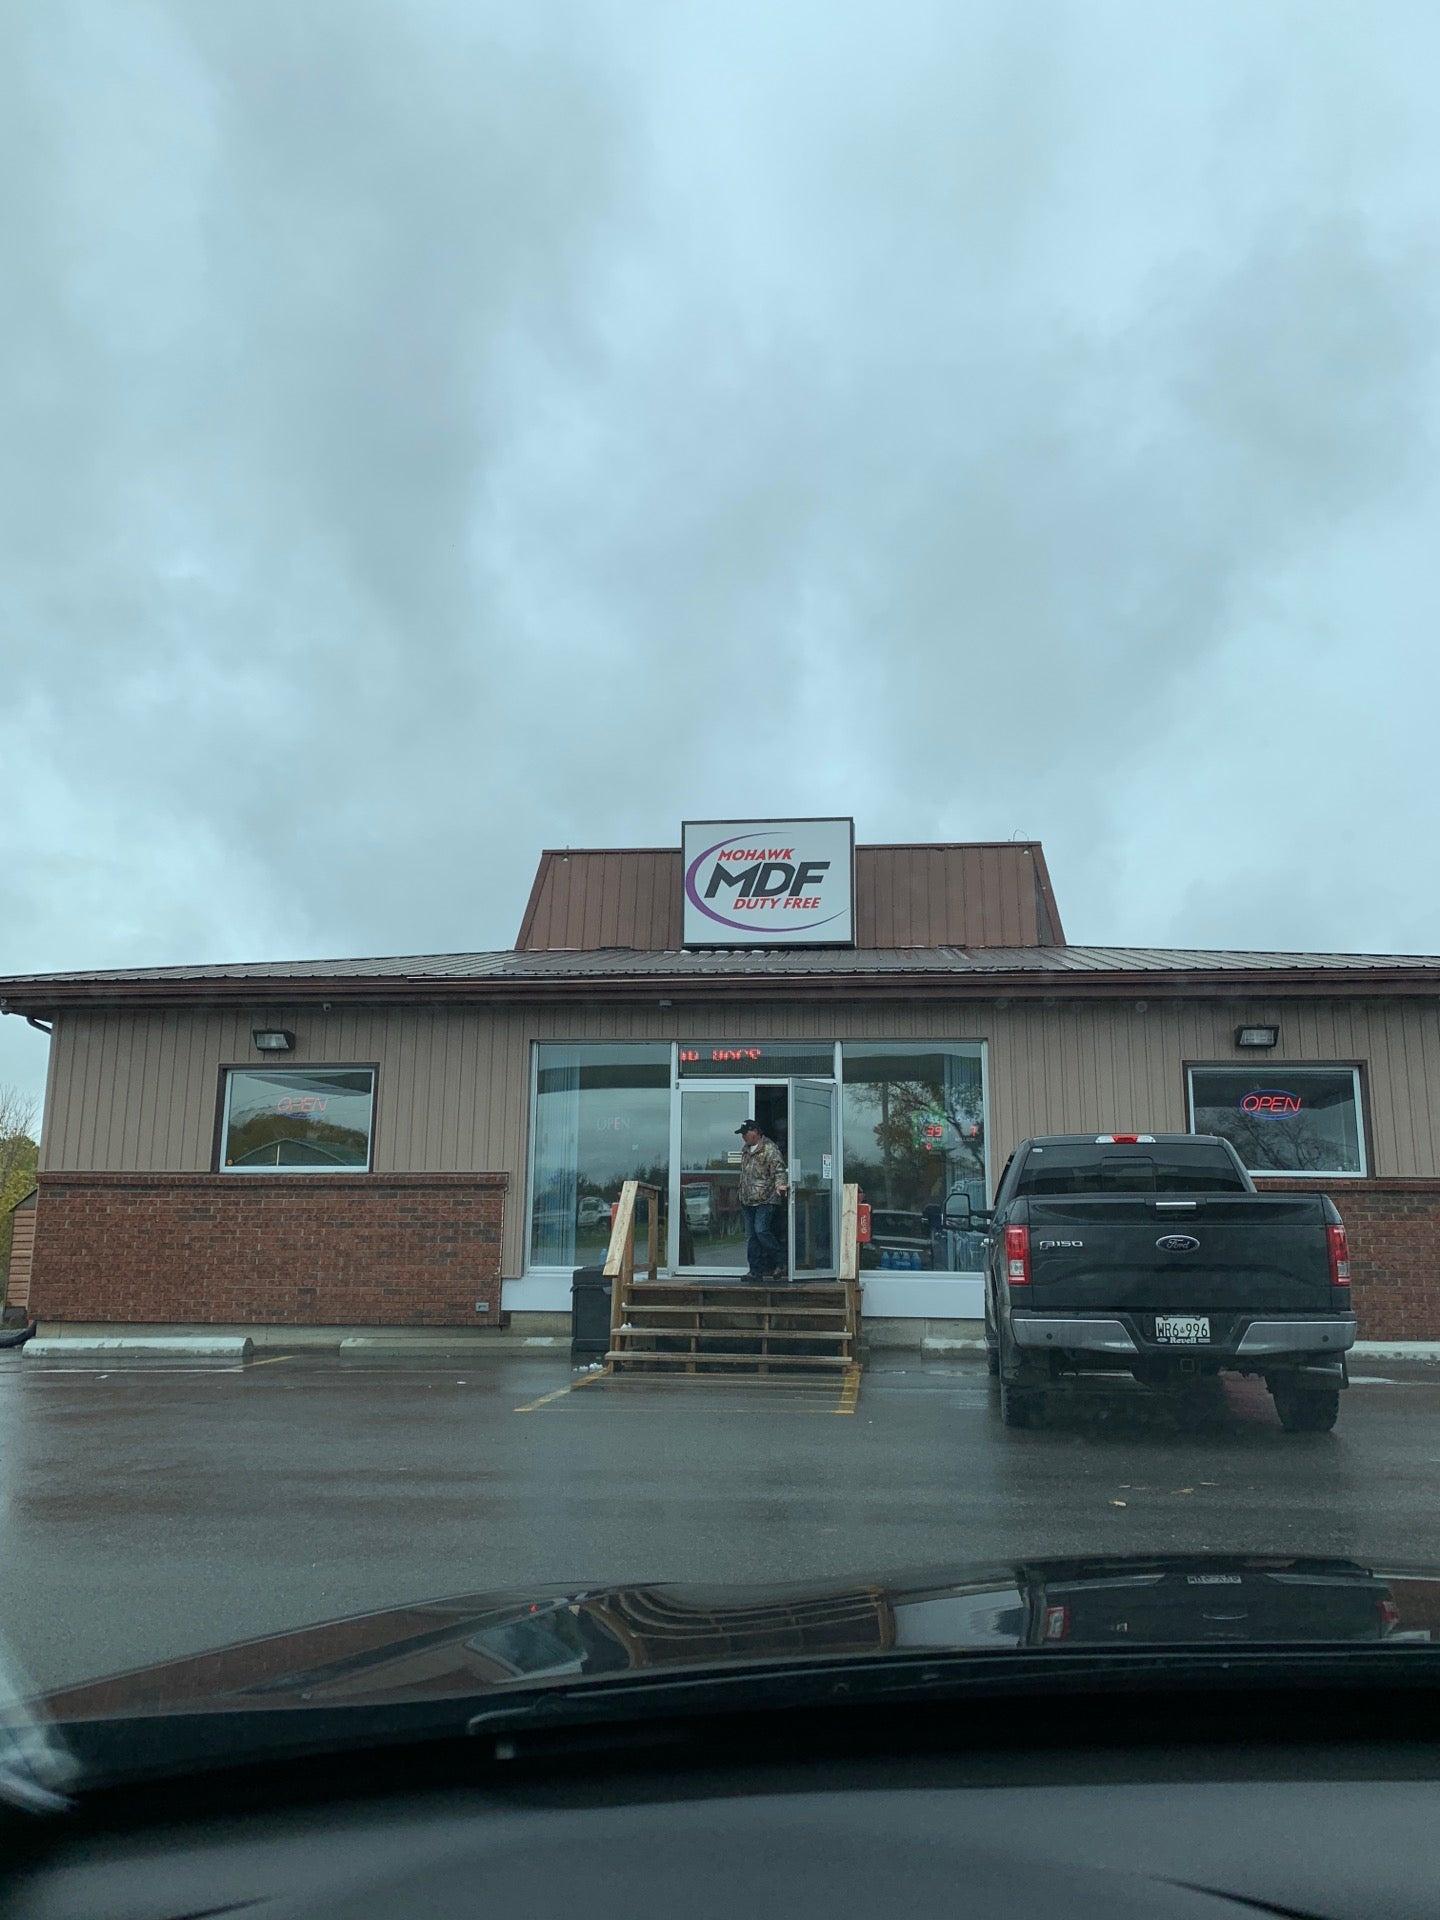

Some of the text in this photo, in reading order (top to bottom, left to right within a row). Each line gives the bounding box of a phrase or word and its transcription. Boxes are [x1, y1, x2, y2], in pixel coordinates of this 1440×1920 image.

[717, 848, 795, 861] MOHAWK
[704, 861, 831, 898] MDF
[733, 897, 821, 910] DUTY FREE
[1243, 1096, 1302, 1112] OPEN
